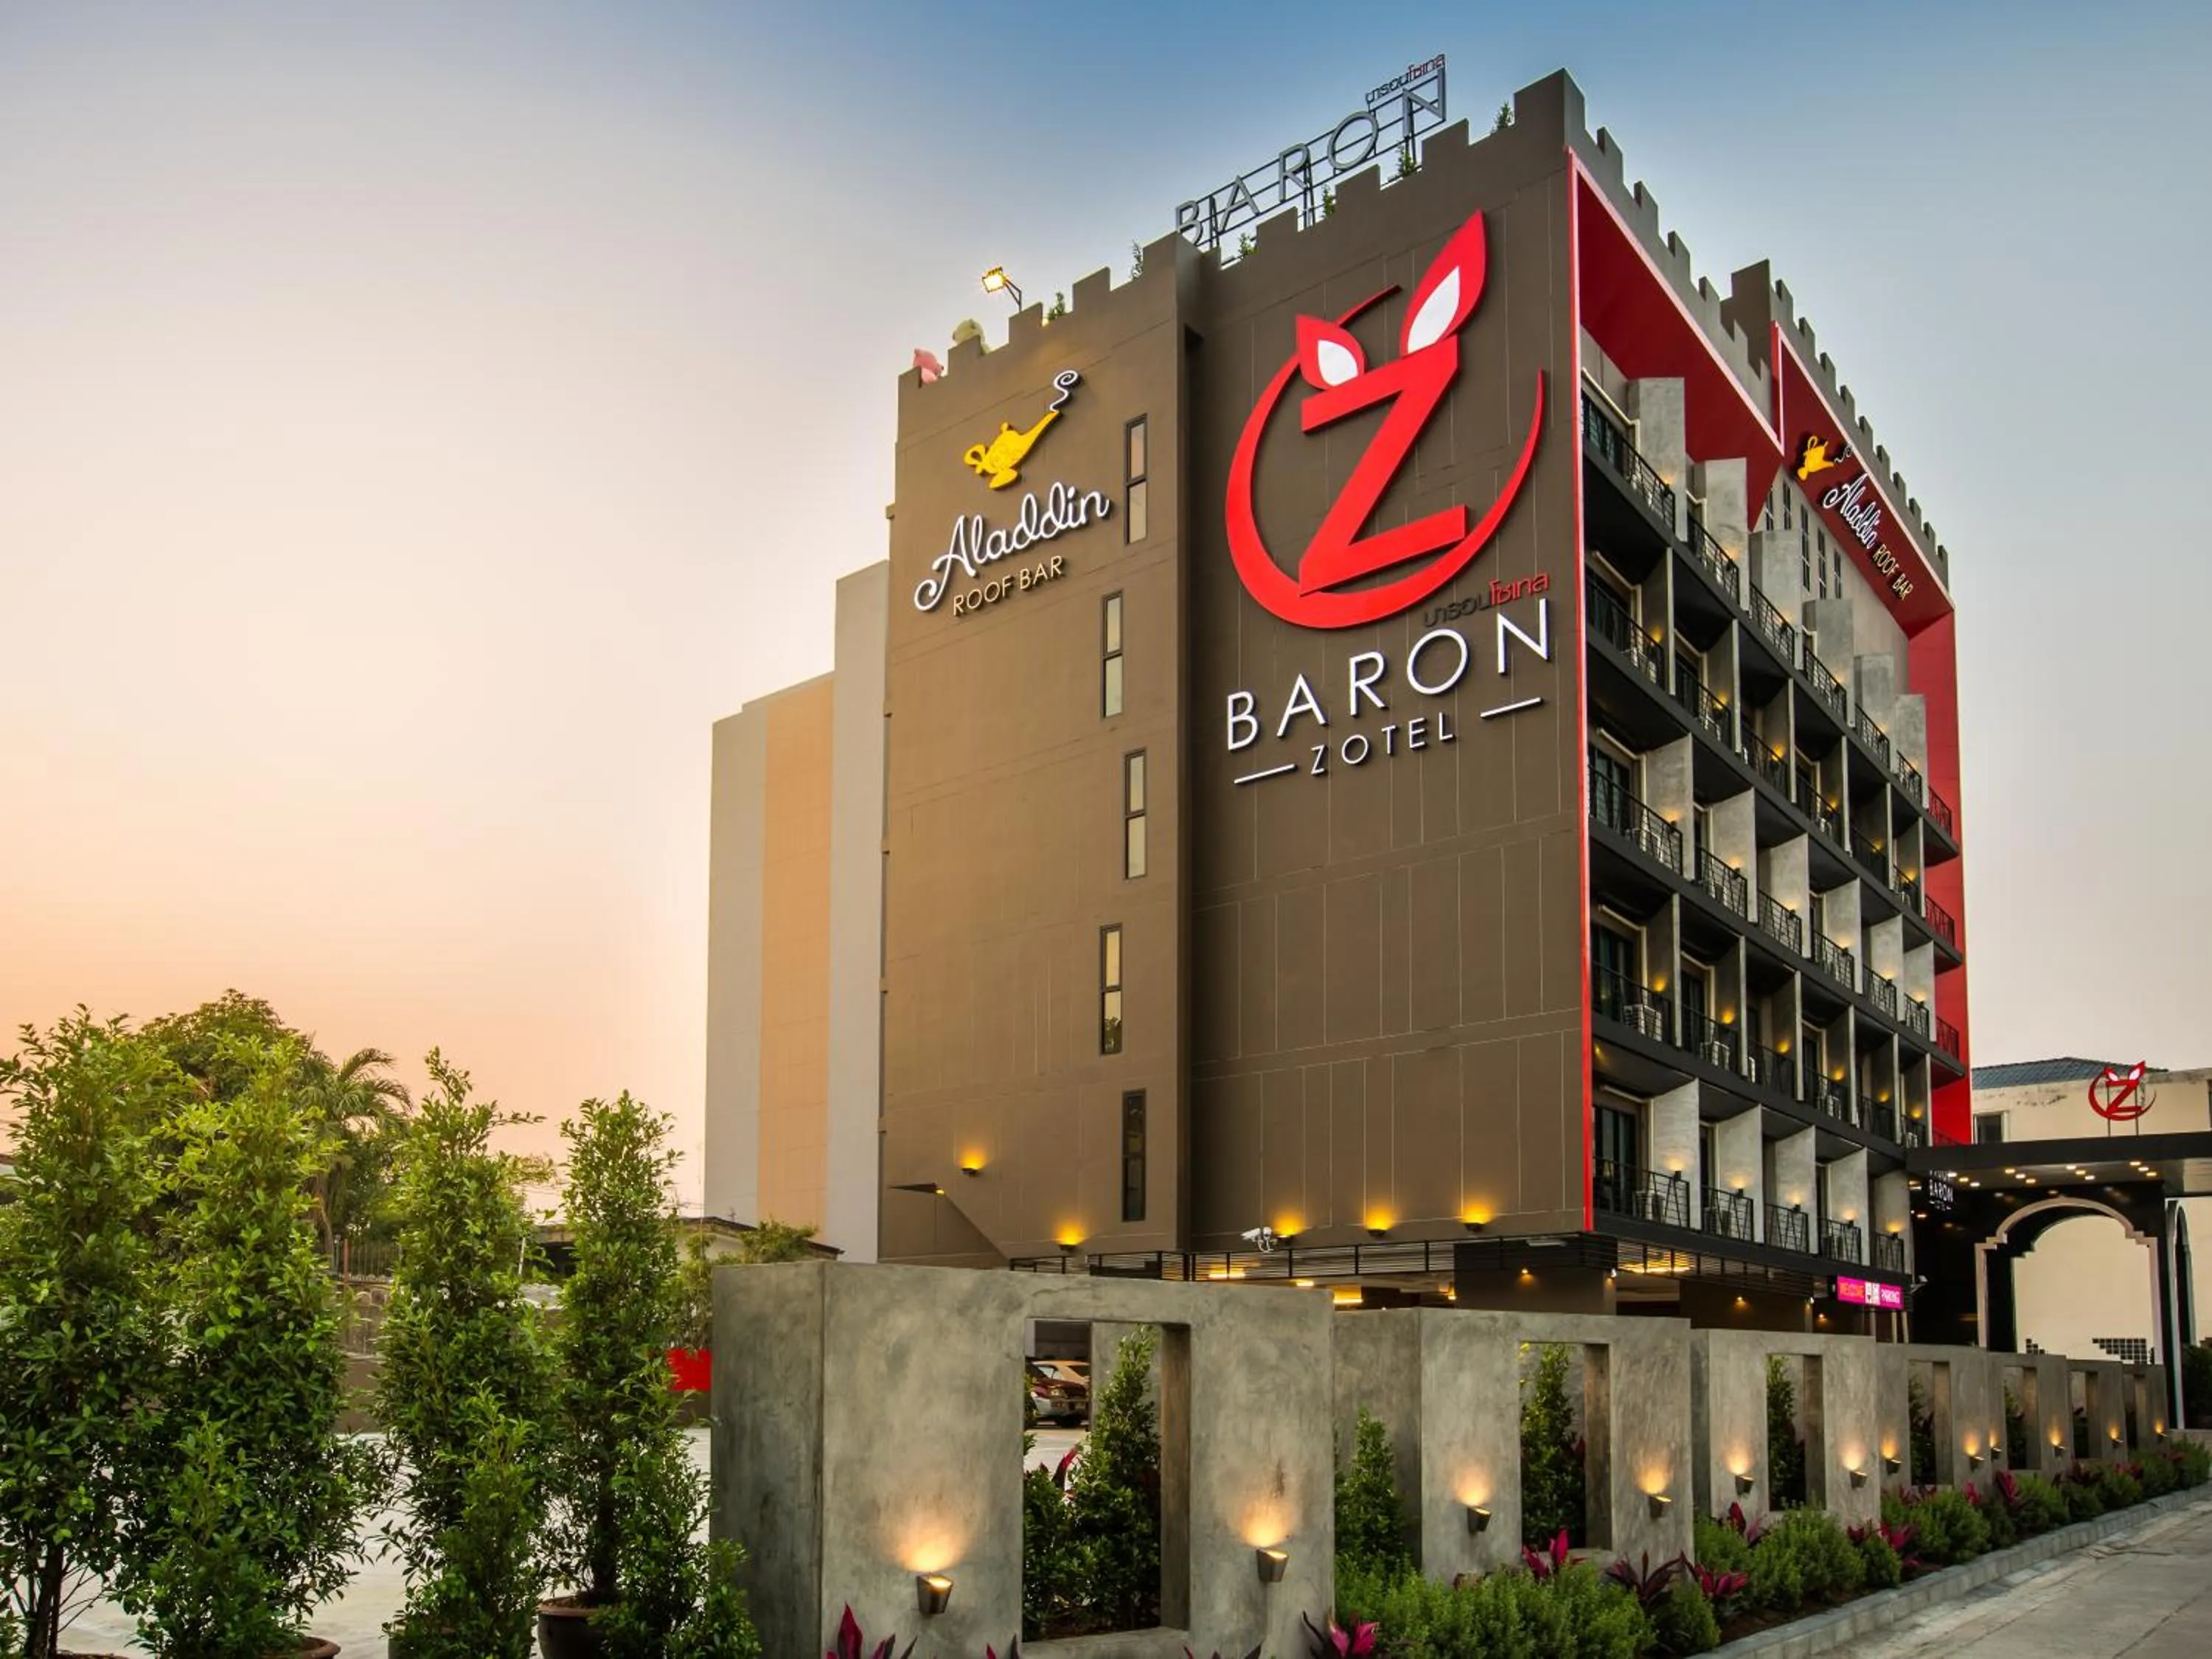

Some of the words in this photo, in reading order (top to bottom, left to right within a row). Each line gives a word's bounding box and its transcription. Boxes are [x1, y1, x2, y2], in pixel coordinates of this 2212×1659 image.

[1175, 67, 1447, 246] BARON
[914, 481, 1110, 611] Aladdin
[953, 575, 1012, 616] ROOF
[1020, 555, 1063, 591] BAR
[1823, 473, 1882, 549] Aladdin
[1873, 544, 1900, 576] ROOF
[1893, 573, 1913, 601] BAR
[1228, 598, 1549, 751] BARON
[1311, 712, 1455, 776] ZOTEL
